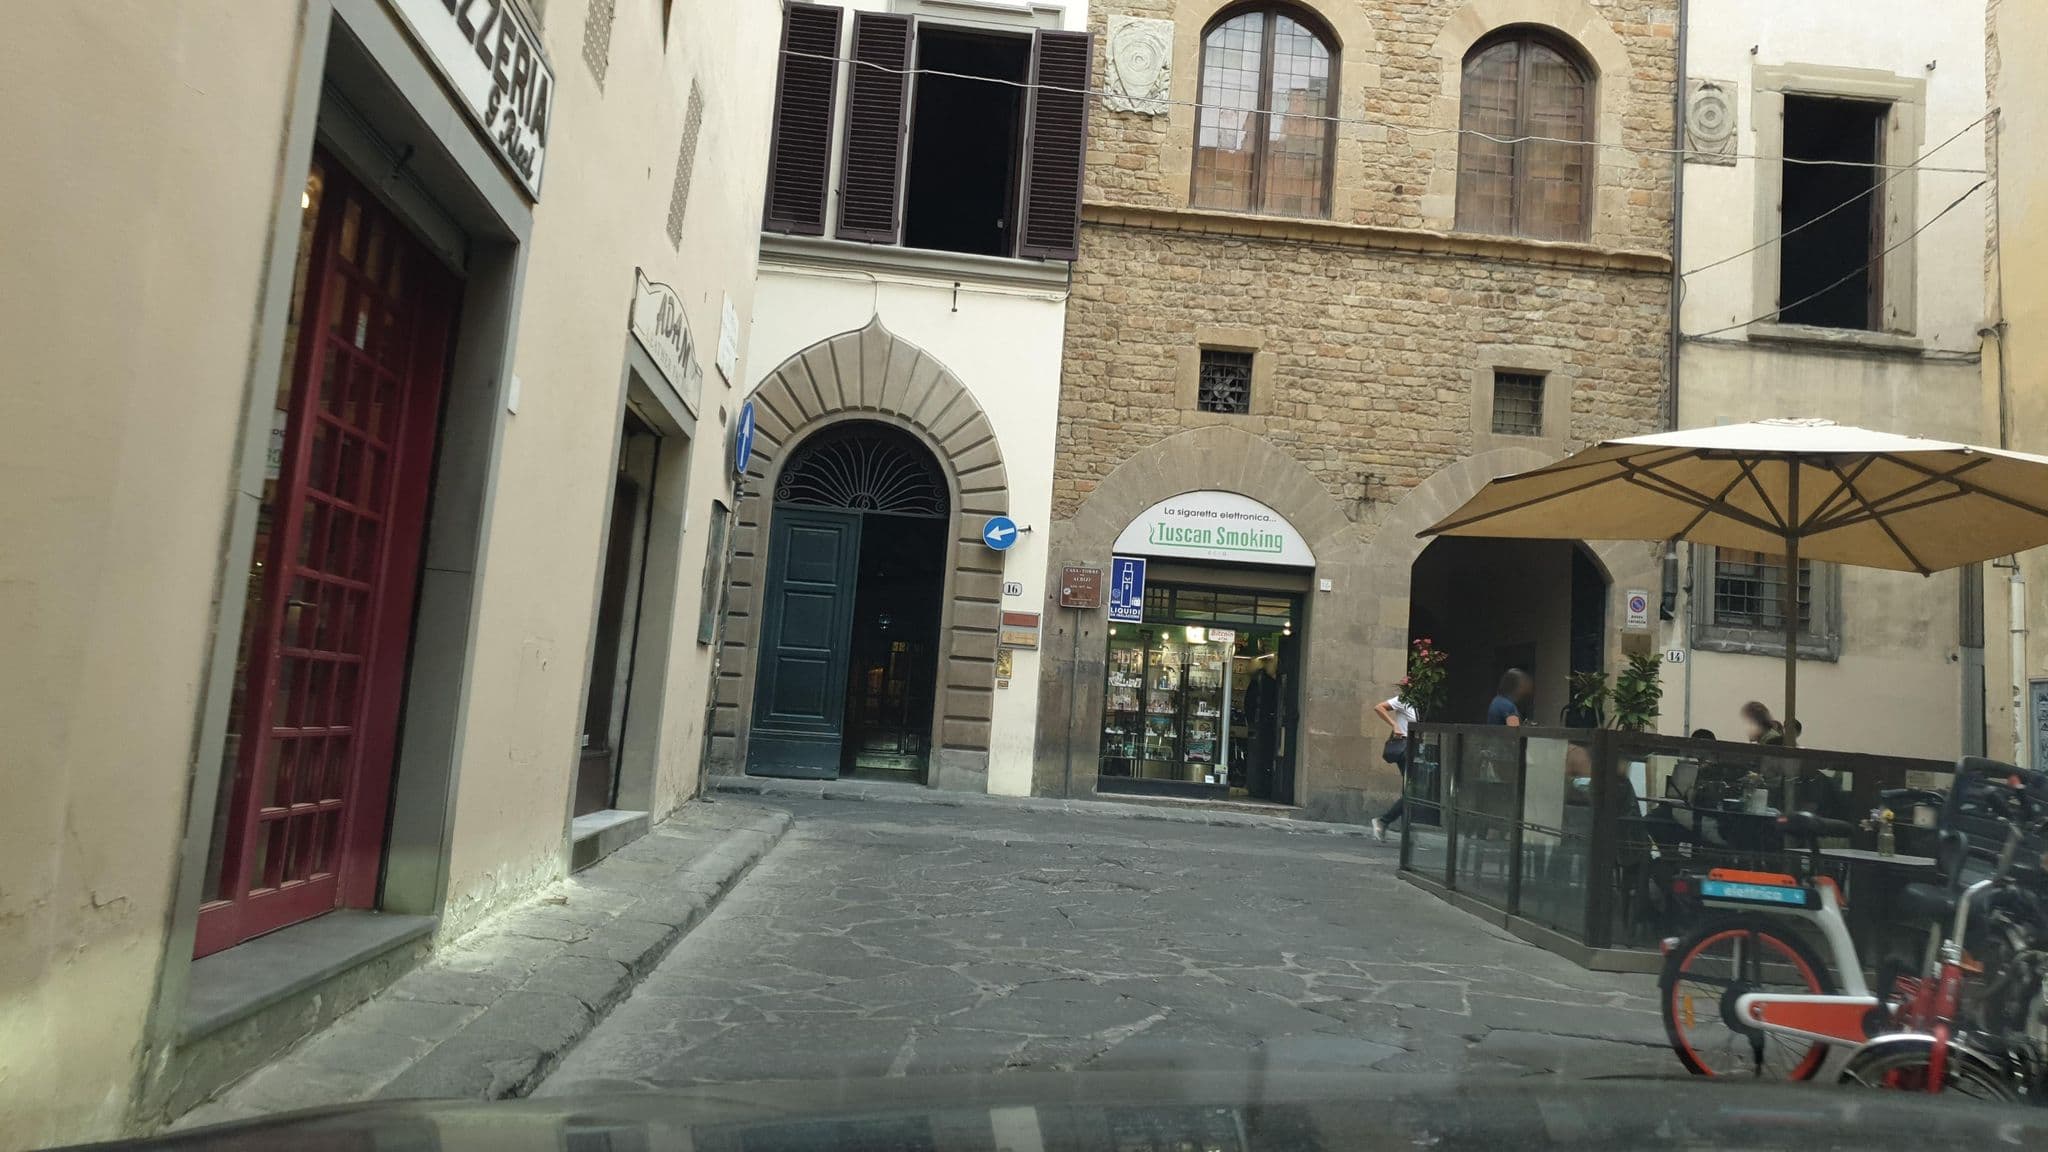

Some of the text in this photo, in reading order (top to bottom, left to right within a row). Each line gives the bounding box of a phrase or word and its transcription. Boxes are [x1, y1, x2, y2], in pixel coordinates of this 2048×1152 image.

[440, 0, 549, 149] ZZERIA
[1164, 506, 1175, 515] La
[1177, 508, 1218, 519] sigaretta
[1158, 522, 1283, 552] Tuscan Smoking
[1007, 584, 1018, 594] 16
[1110, 607, 1141, 615] LIQUIDI
[1669, 651, 1680, 661] 14
